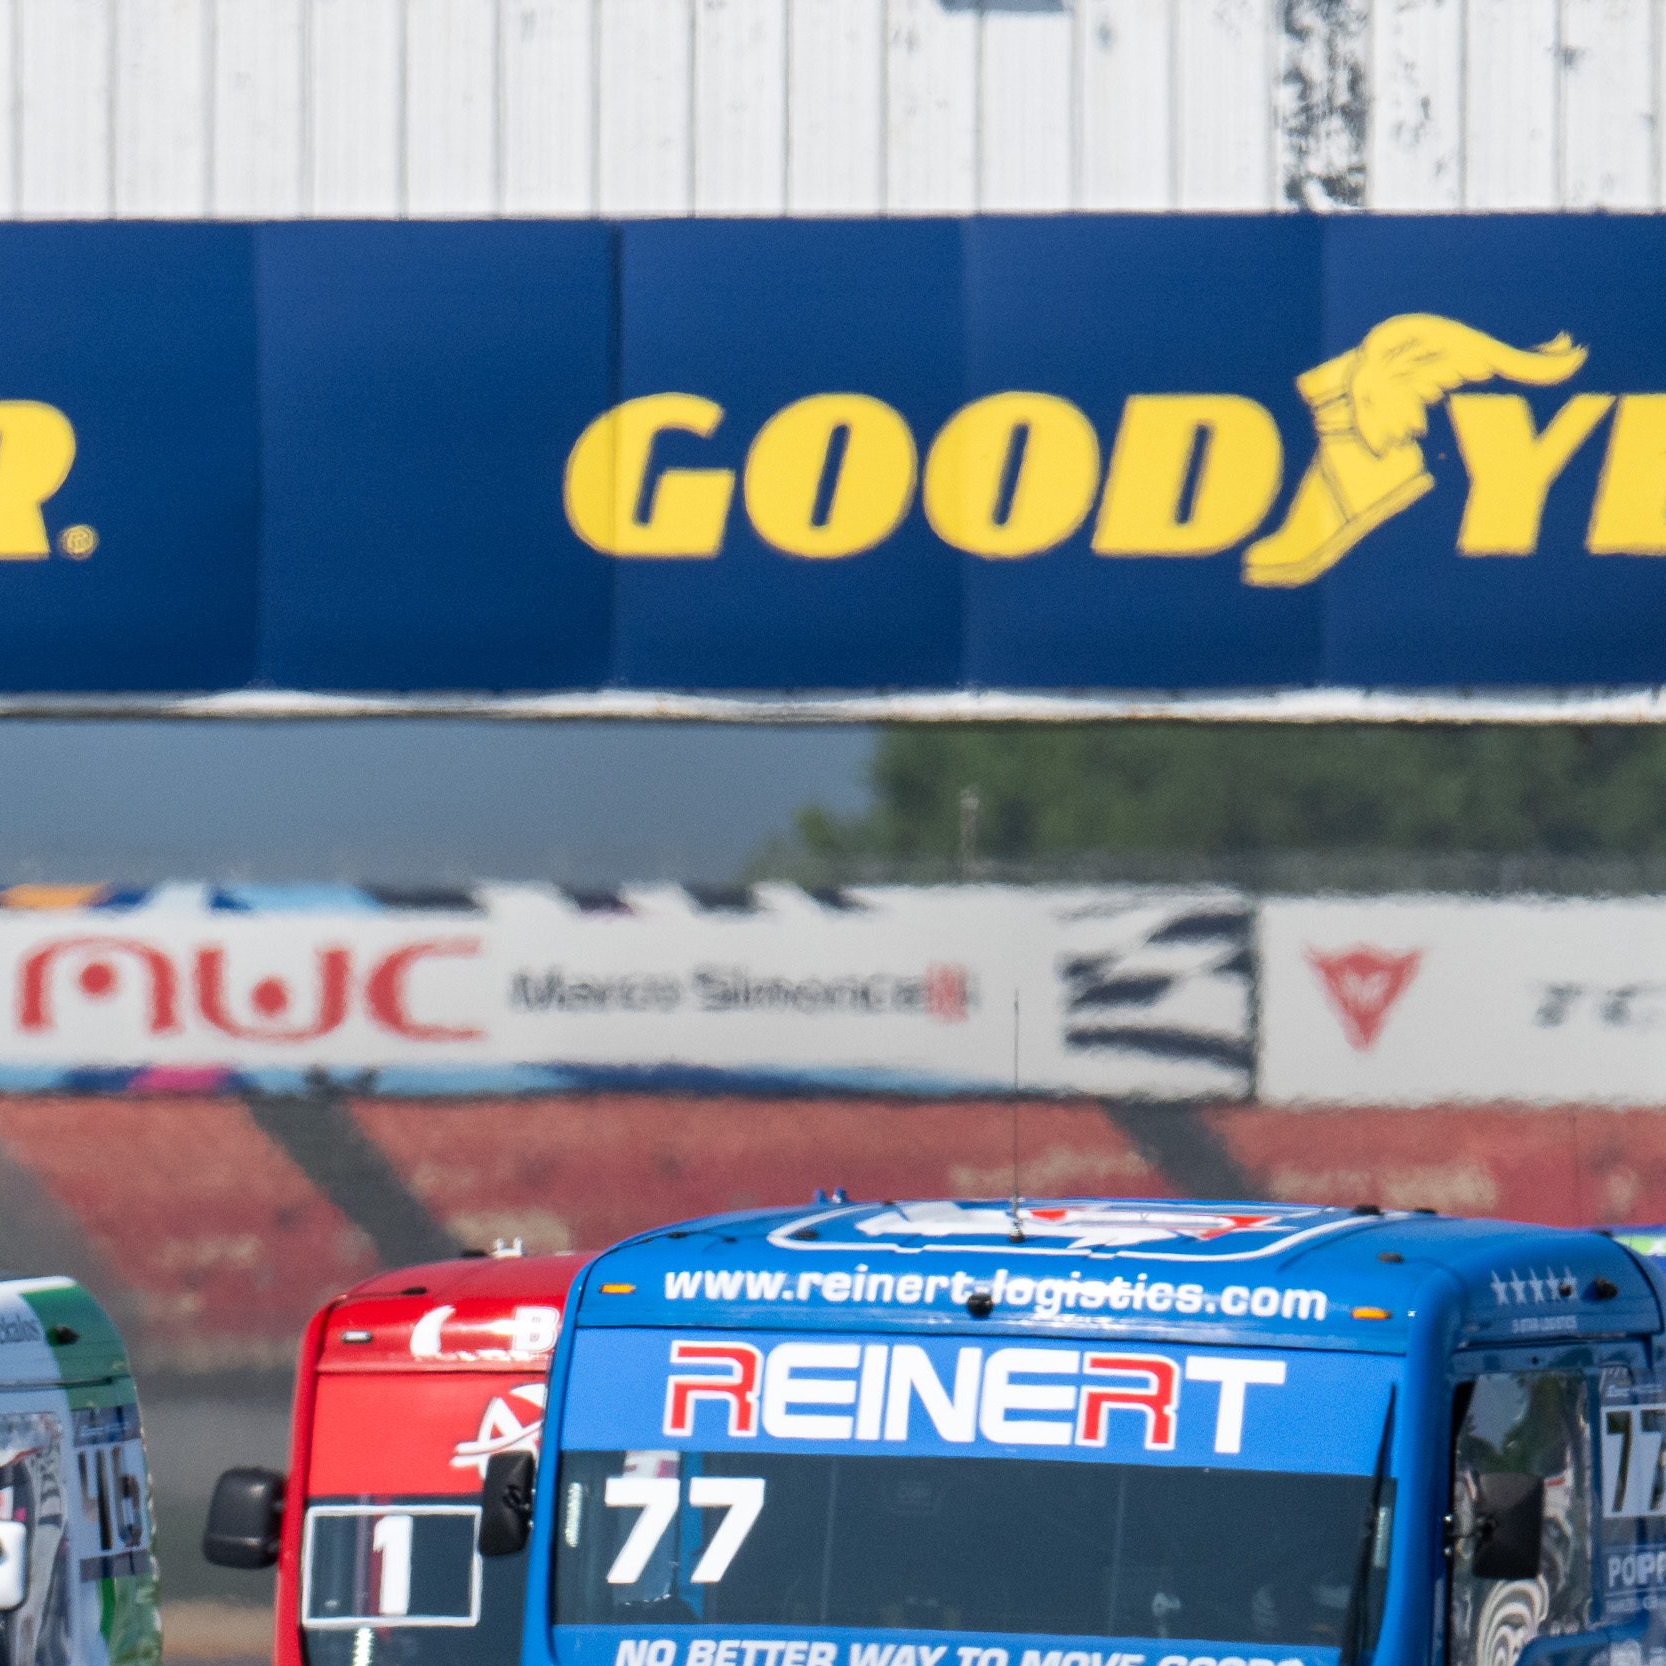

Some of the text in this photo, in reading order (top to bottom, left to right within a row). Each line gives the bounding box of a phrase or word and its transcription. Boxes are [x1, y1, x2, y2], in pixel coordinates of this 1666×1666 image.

[664, 1265, 1329, 1322] www.reinert-logistics.com
[661, 1339, 1288, 1455] REINERT
[373, 1513, 414, 1616] 1
[603, 1476, 766, 1585] 77
